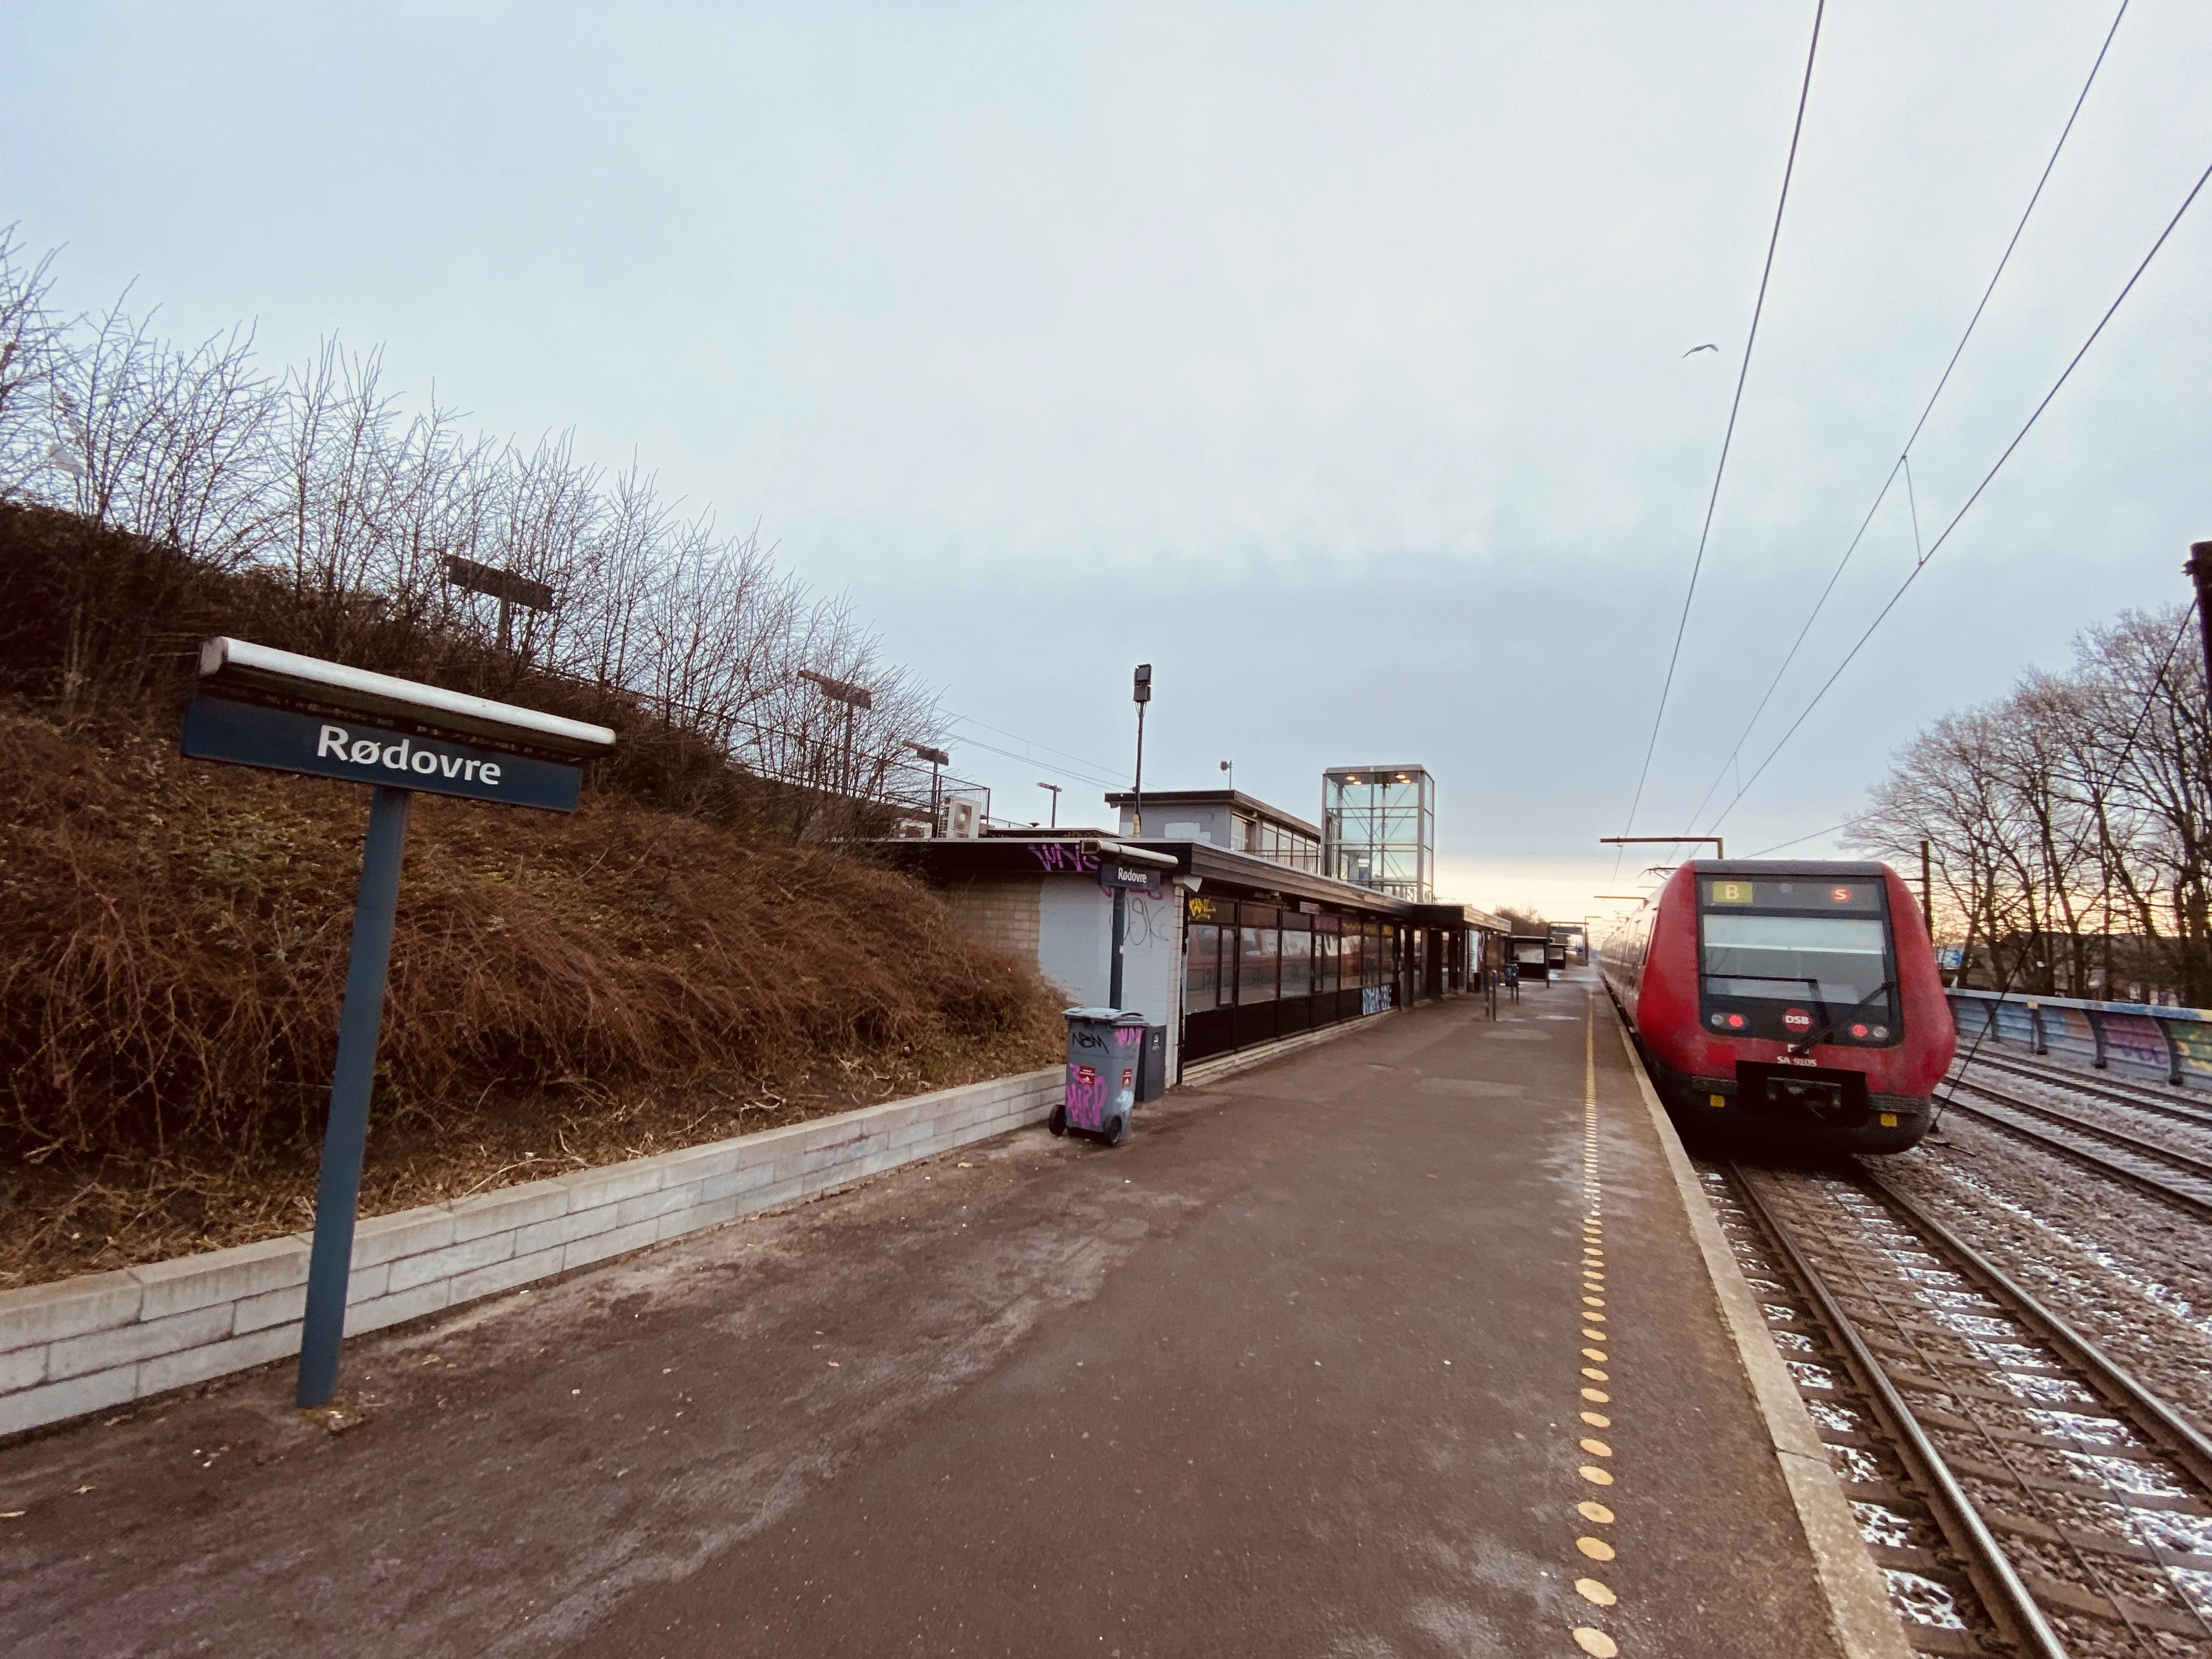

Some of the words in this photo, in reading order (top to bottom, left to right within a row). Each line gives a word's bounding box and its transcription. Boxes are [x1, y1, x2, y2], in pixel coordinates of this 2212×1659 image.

[317, 725, 501, 785] Rødovre
[1725, 884, 1740, 900] B
[1834, 889, 1847, 900] S
[1785, 1014, 1809, 1025] DSB
